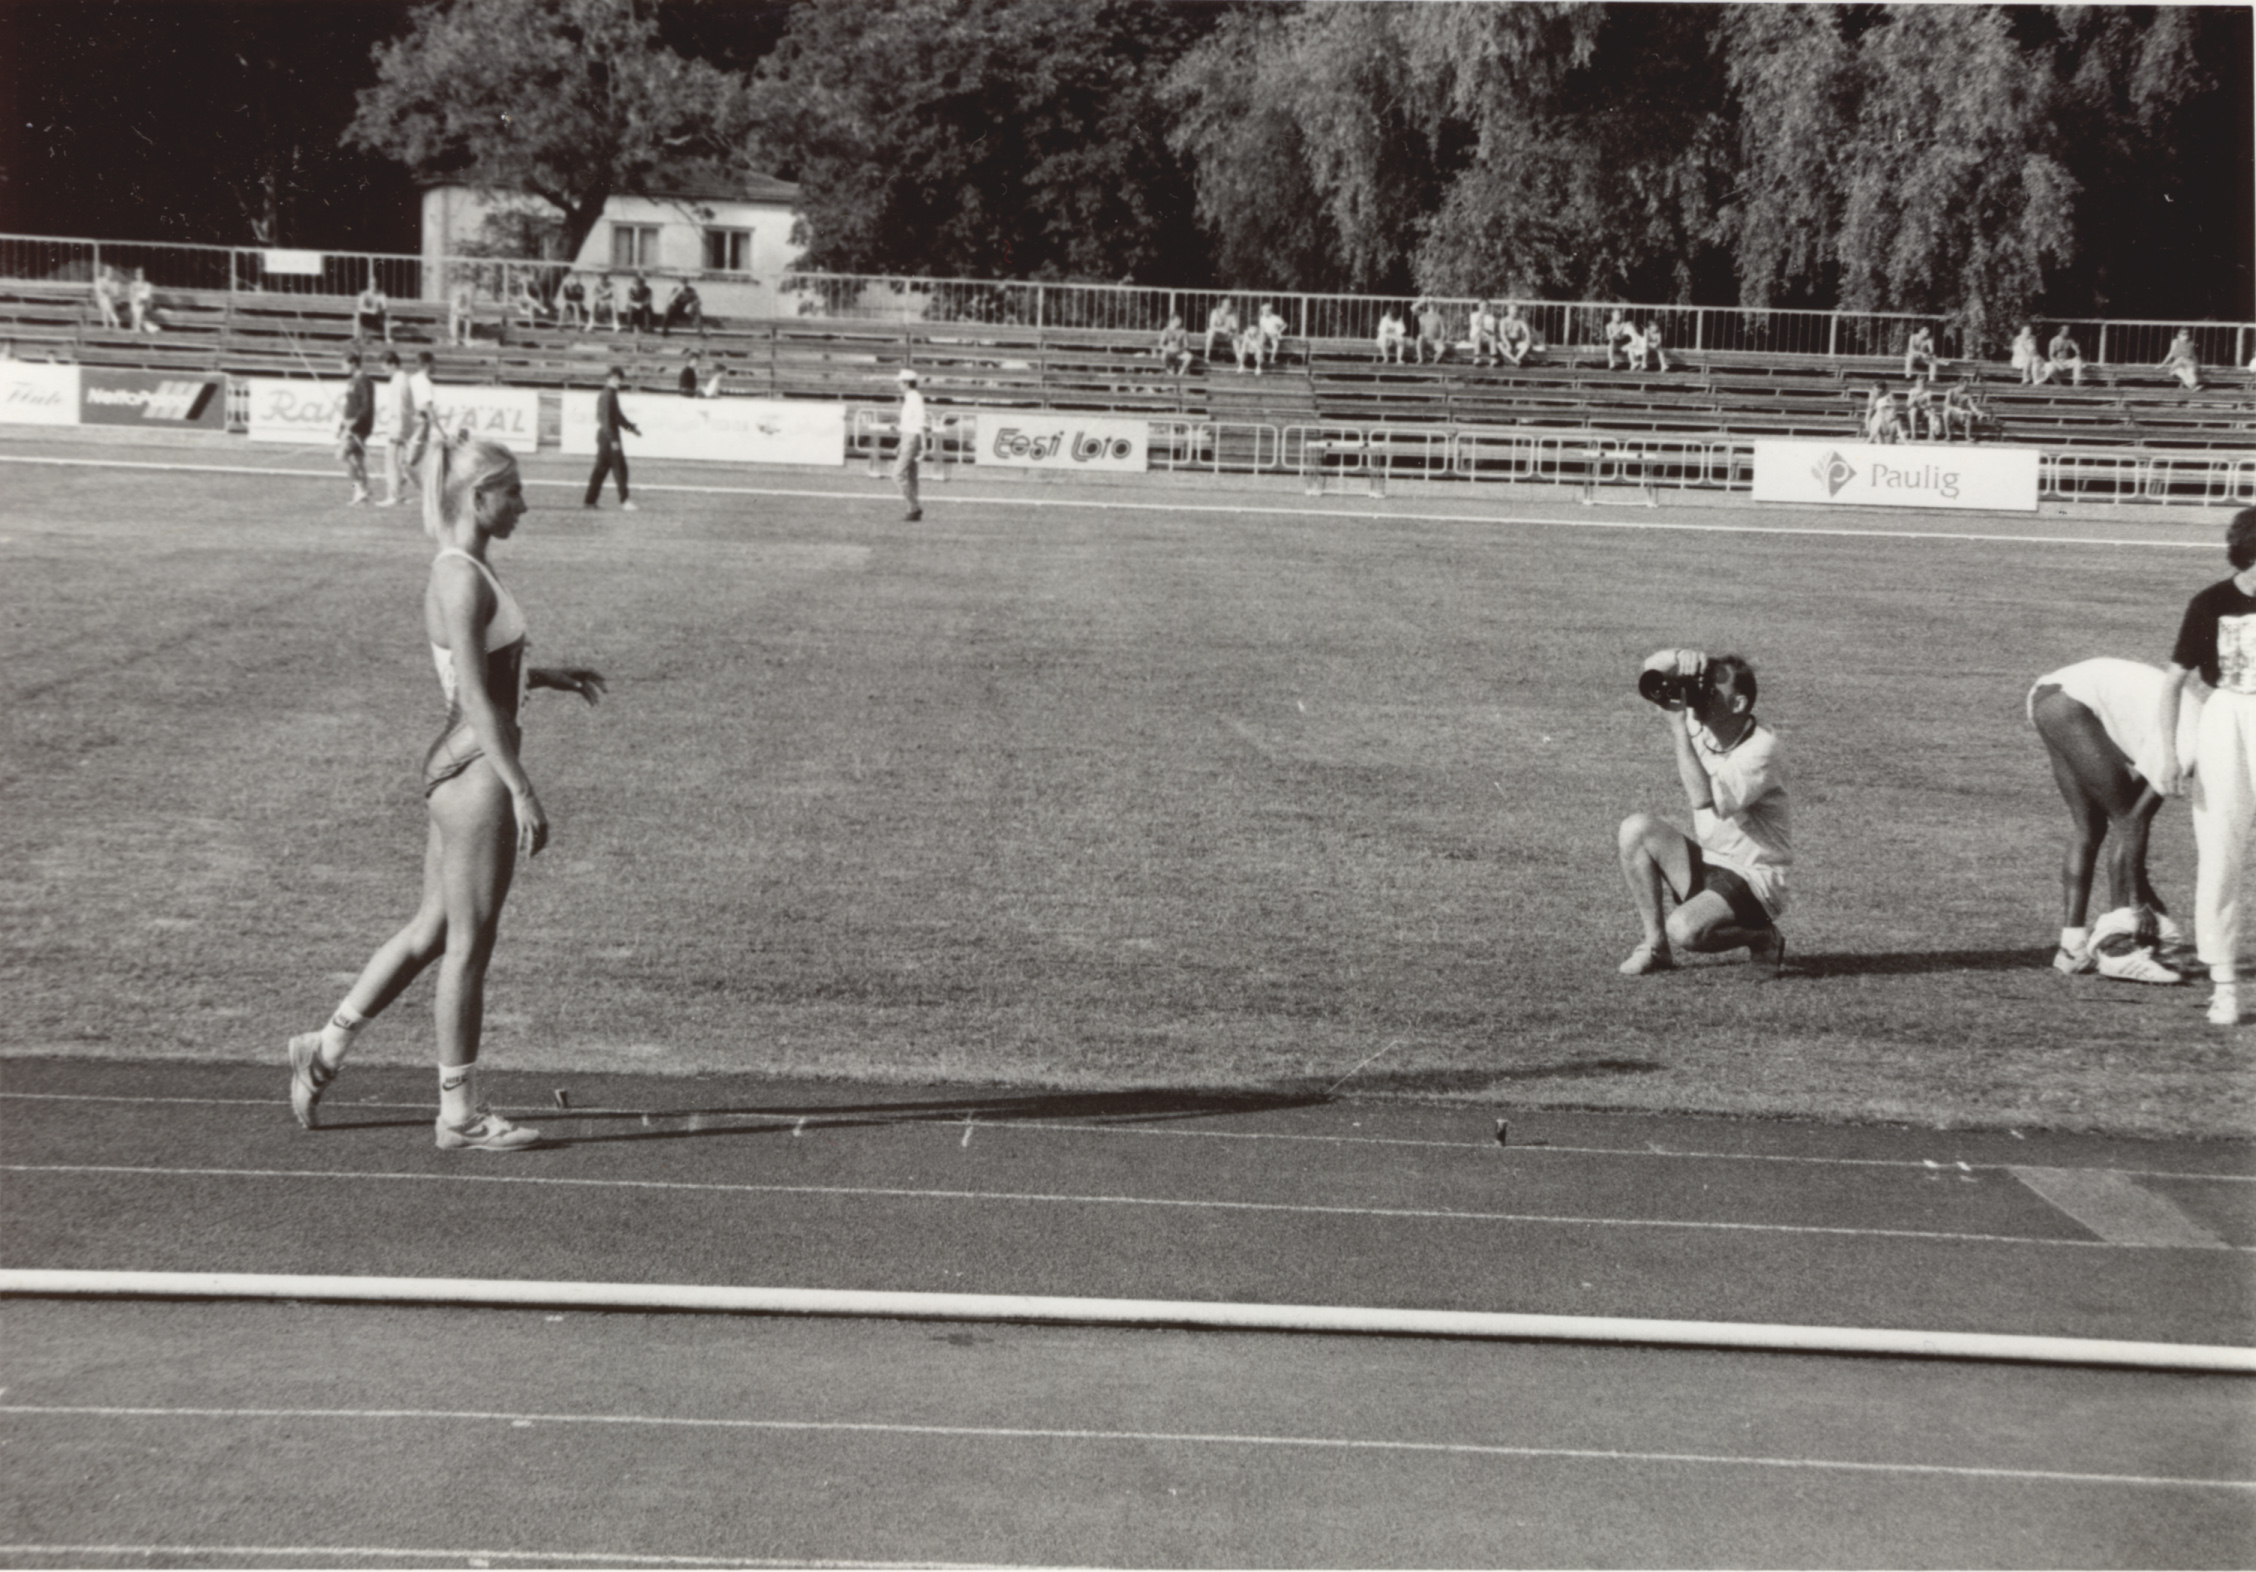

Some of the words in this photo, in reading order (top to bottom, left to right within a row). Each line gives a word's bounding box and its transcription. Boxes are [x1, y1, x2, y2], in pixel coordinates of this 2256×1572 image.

[993, 427, 1065, 461] Eesti
[1071, 431, 1132, 463] Loto
[1870, 463, 1961, 500] Paulig
